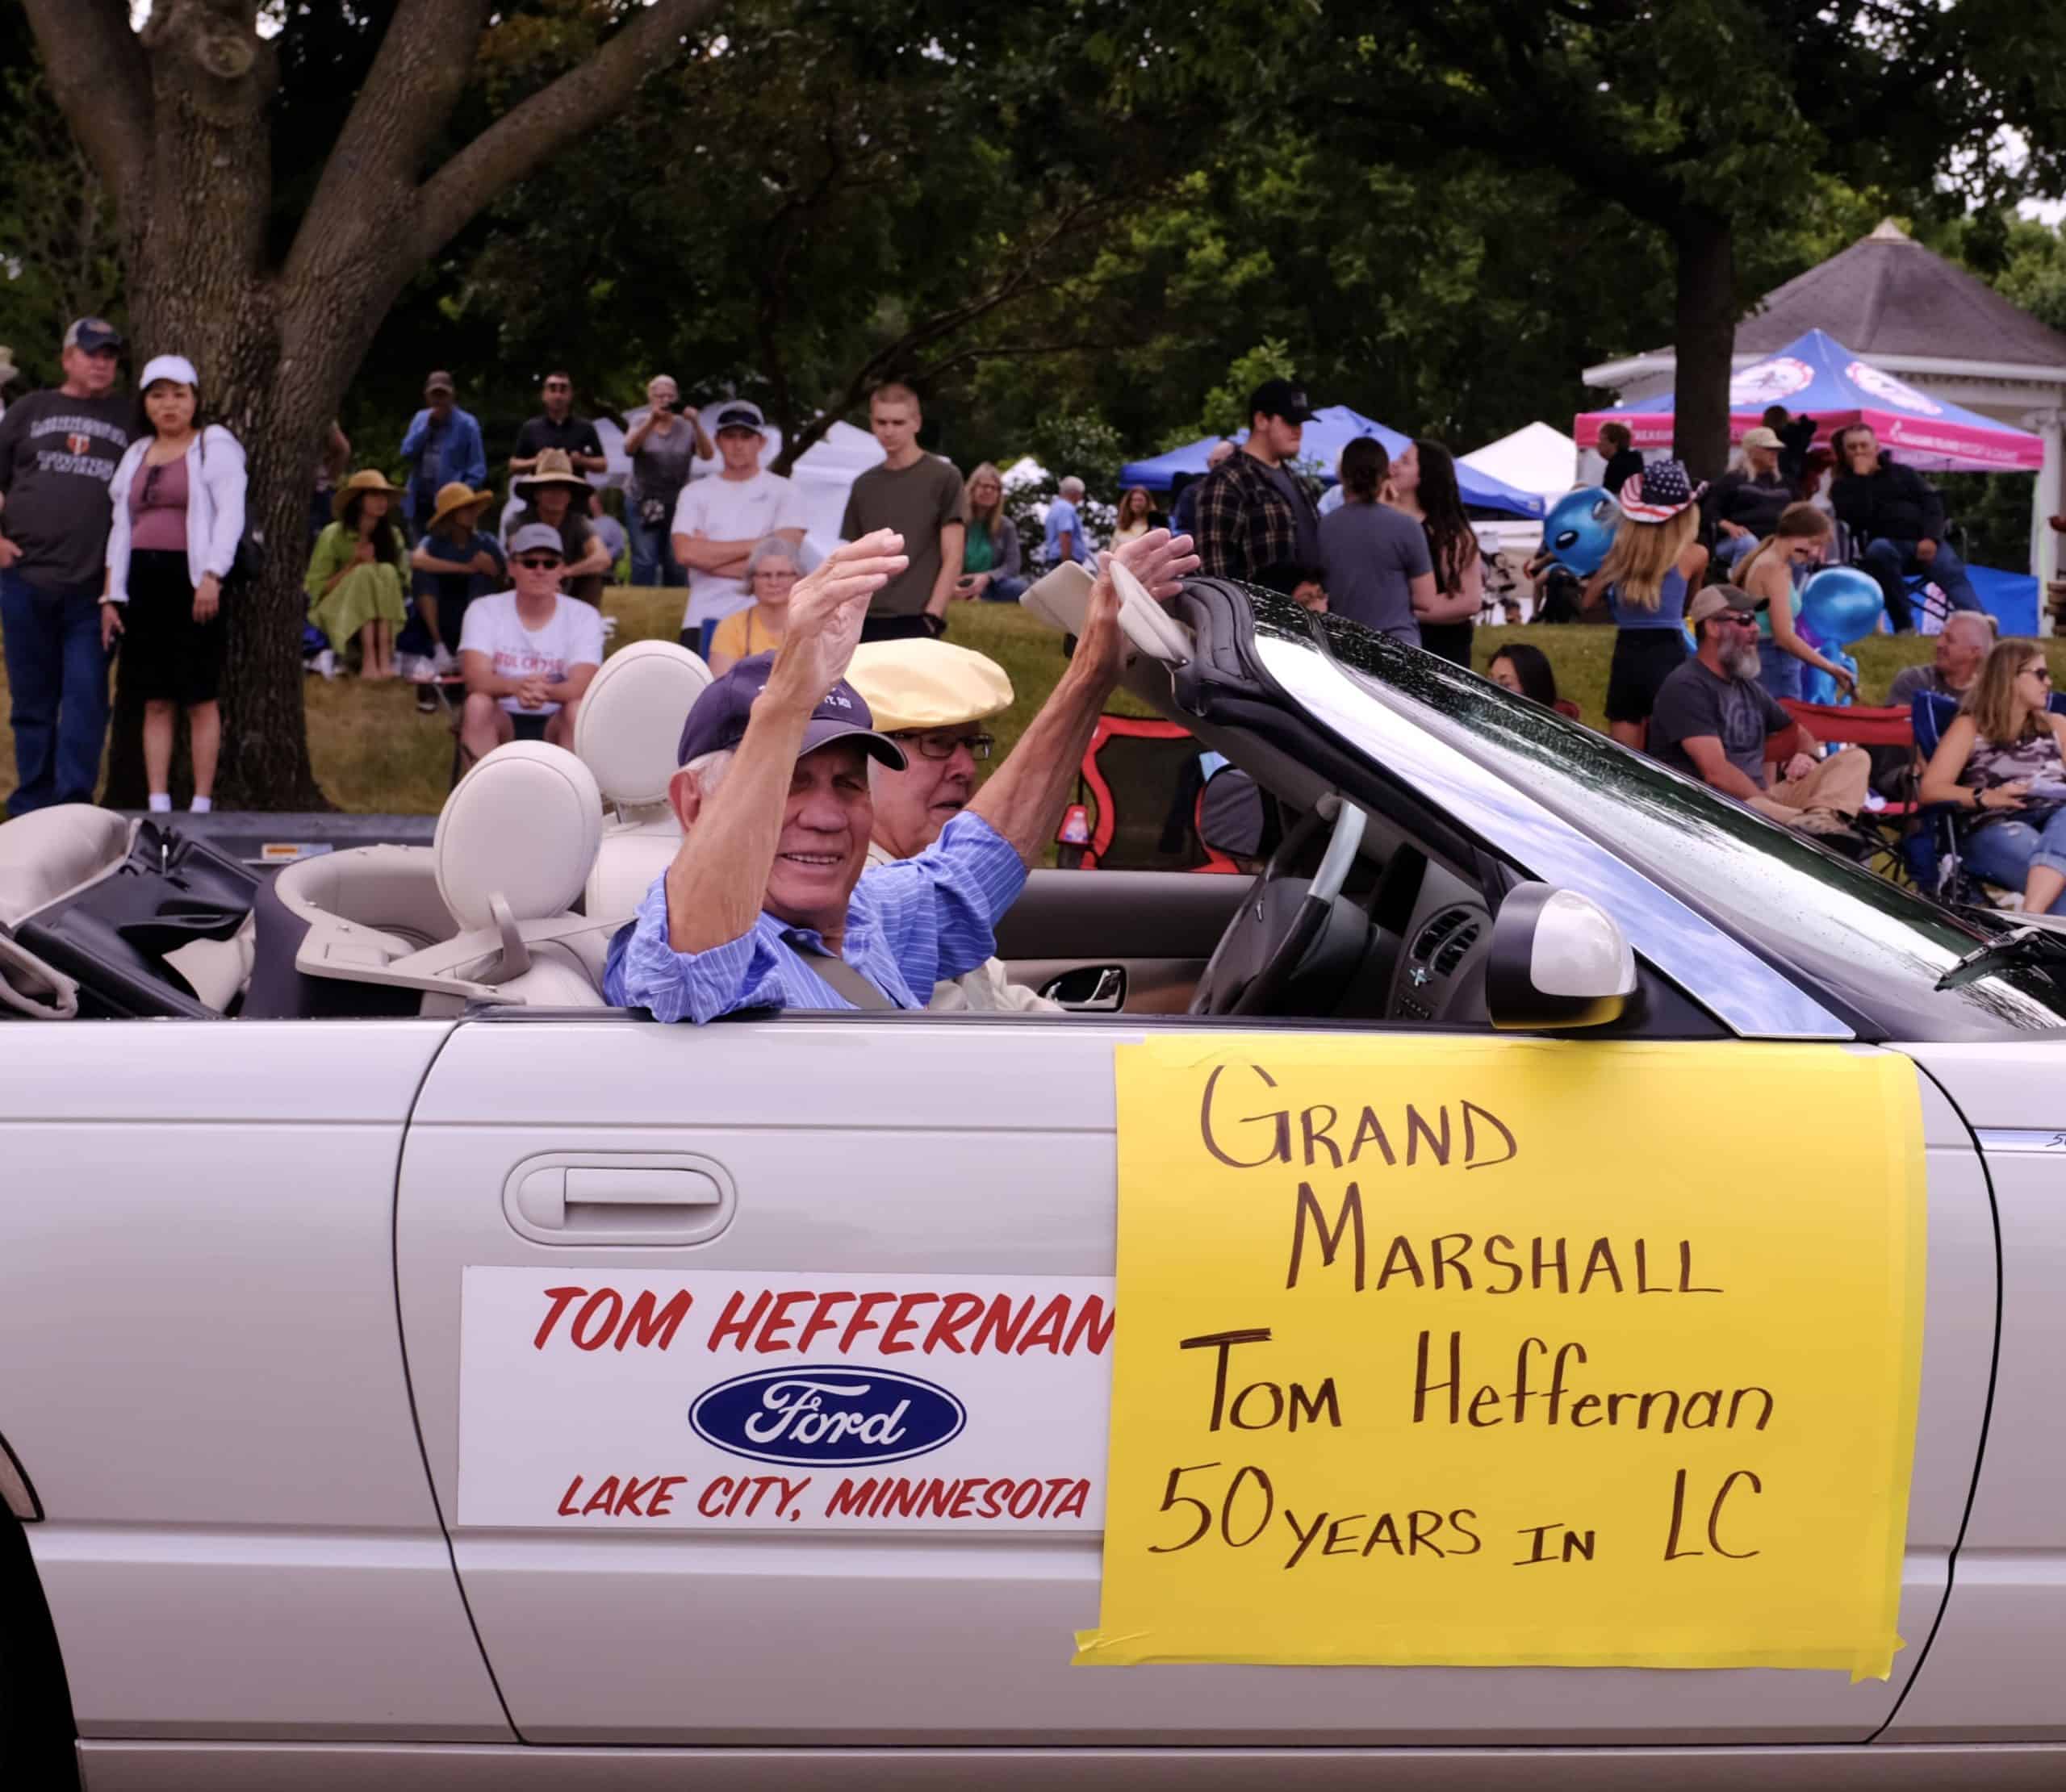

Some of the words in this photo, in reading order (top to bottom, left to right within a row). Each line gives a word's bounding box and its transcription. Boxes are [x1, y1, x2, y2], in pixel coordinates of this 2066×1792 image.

[1201, 1065, 1517, 1170] GRAND
[1286, 1182, 1724, 1294] MARSHALL
[533, 1286, 694, 1351] TOM
[707, 1290, 1115, 1355] HEFFERNAN
[744, 1380, 912, 1445] Ford
[1413, 1330, 1774, 1434] Heffernan
[558, 1475, 688, 1517] LAKE
[697, 1476, 812, 1521] CITY,
[825, 1477, 1091, 1519] MINNESOTA
[1512, 1523, 1596, 1566] IN
[1663, 1468, 1763, 1561] LC
